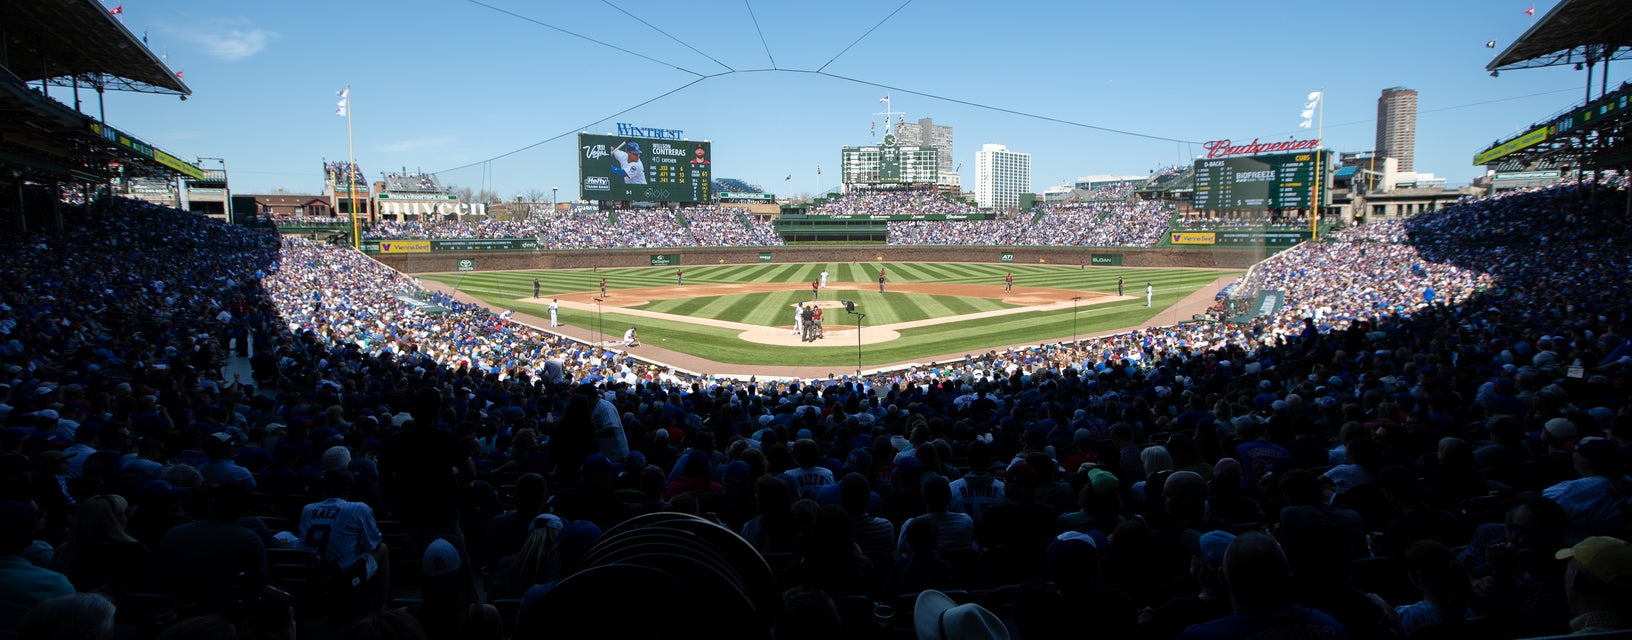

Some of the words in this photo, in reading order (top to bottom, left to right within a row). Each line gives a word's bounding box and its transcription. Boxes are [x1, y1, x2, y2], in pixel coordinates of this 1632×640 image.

[616, 122, 683, 139] WINTRUST
[652, 148, 686, 156] CONTRERAS
[1203, 136, 1321, 158] Budweiser
[1236, 171, 1276, 179] BIOFREEZE
[383, 202, 486, 216] nuveen
[798, 474, 825, 486] RIZZO
[960, 486, 996, 498] BRYANT
[305, 524, 332, 560] 9
